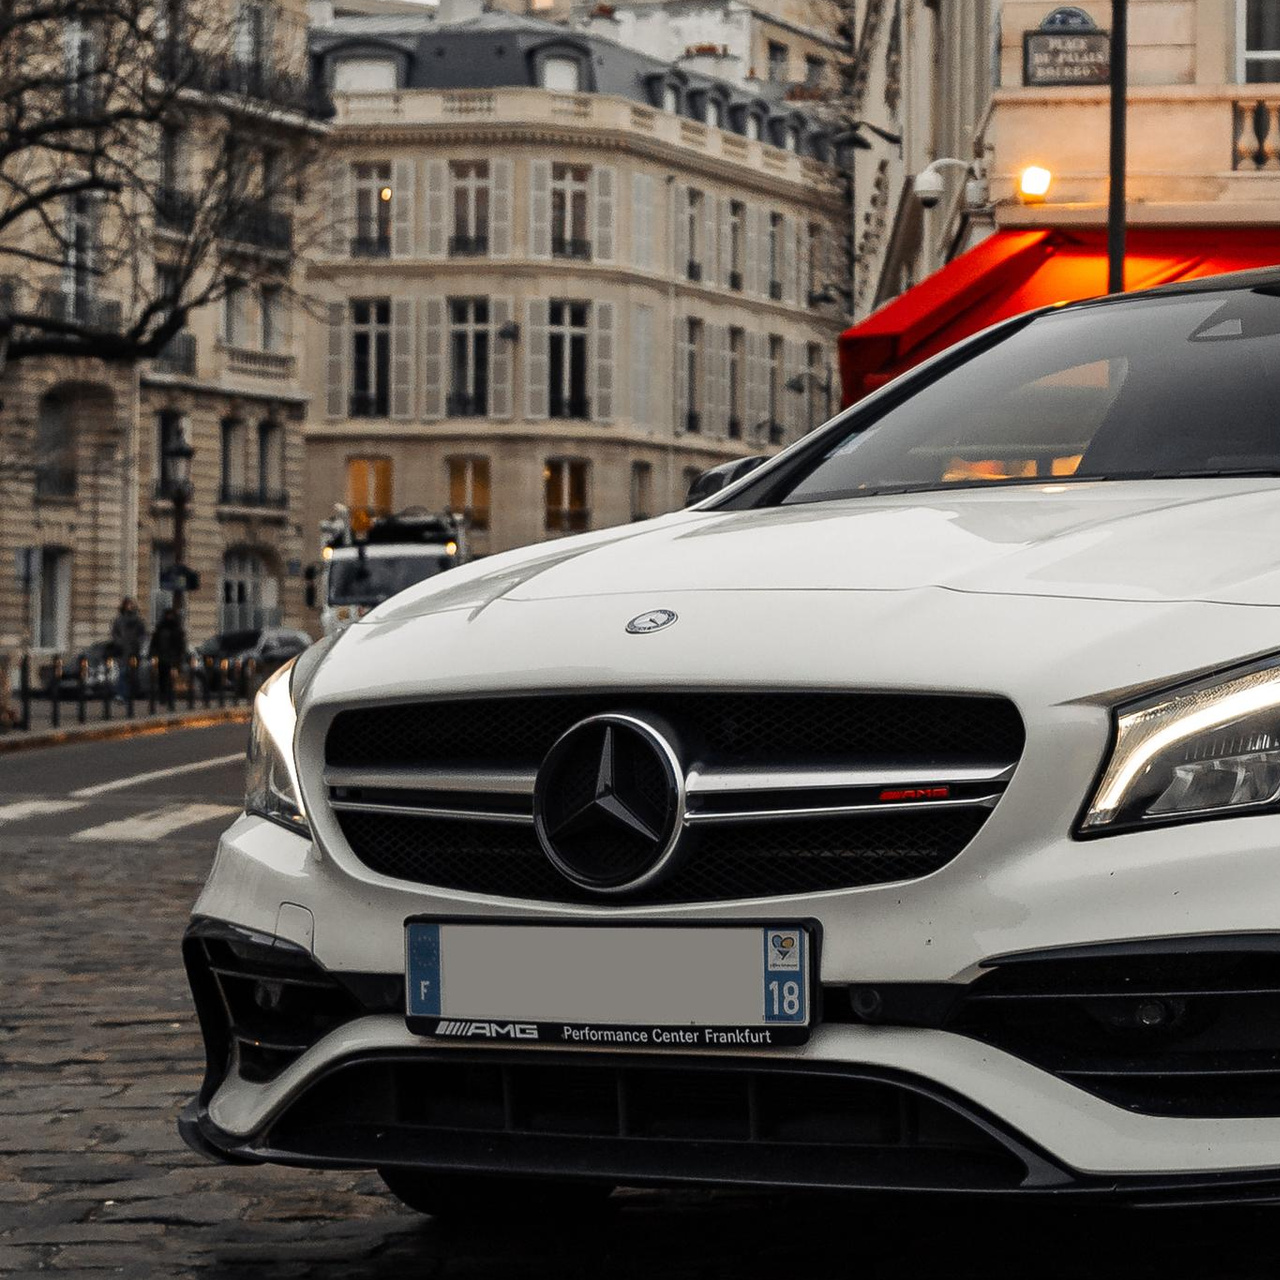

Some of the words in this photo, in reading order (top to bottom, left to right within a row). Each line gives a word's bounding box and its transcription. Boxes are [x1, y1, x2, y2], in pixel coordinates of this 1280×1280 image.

[1058, 52, 1104, 64] PALAIS
[419, 980, 430, 1000] F
[769, 981, 800, 1015] 18
[466, 1022, 539, 1039] AMG
[563, 1026, 648, 1044] Performance
[652, 1028, 699, 1044] Center
[705, 1029, 772, 1044] Frankfurt
